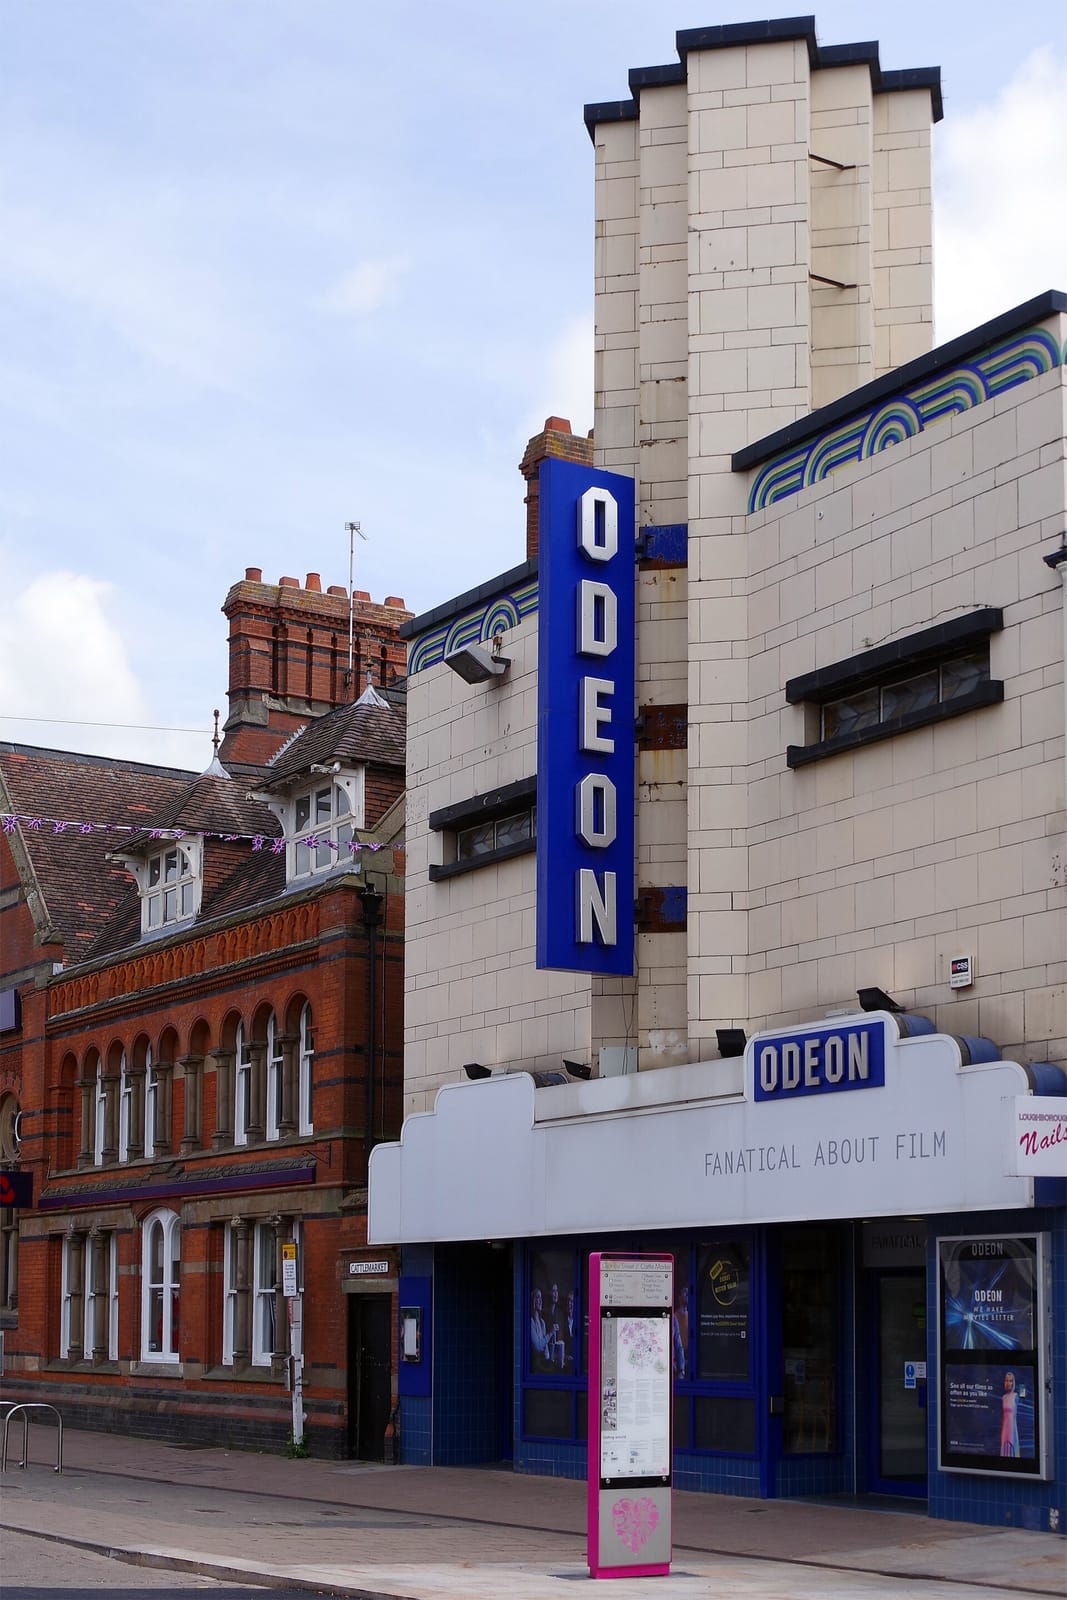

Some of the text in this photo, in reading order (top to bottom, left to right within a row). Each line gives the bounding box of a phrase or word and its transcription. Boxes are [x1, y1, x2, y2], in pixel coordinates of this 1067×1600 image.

[576, 485, 619, 946] ODEON
[760, 1031, 869, 1092] ODEON
[704, 1130, 946, 1177] FANATICAL ABOUT FILM
[971, 1242, 1004, 1257] ODEON
[350, 1262, 388, 1273] CATTLEMARKET
[974, 1290, 1002, 1302] ODEON
